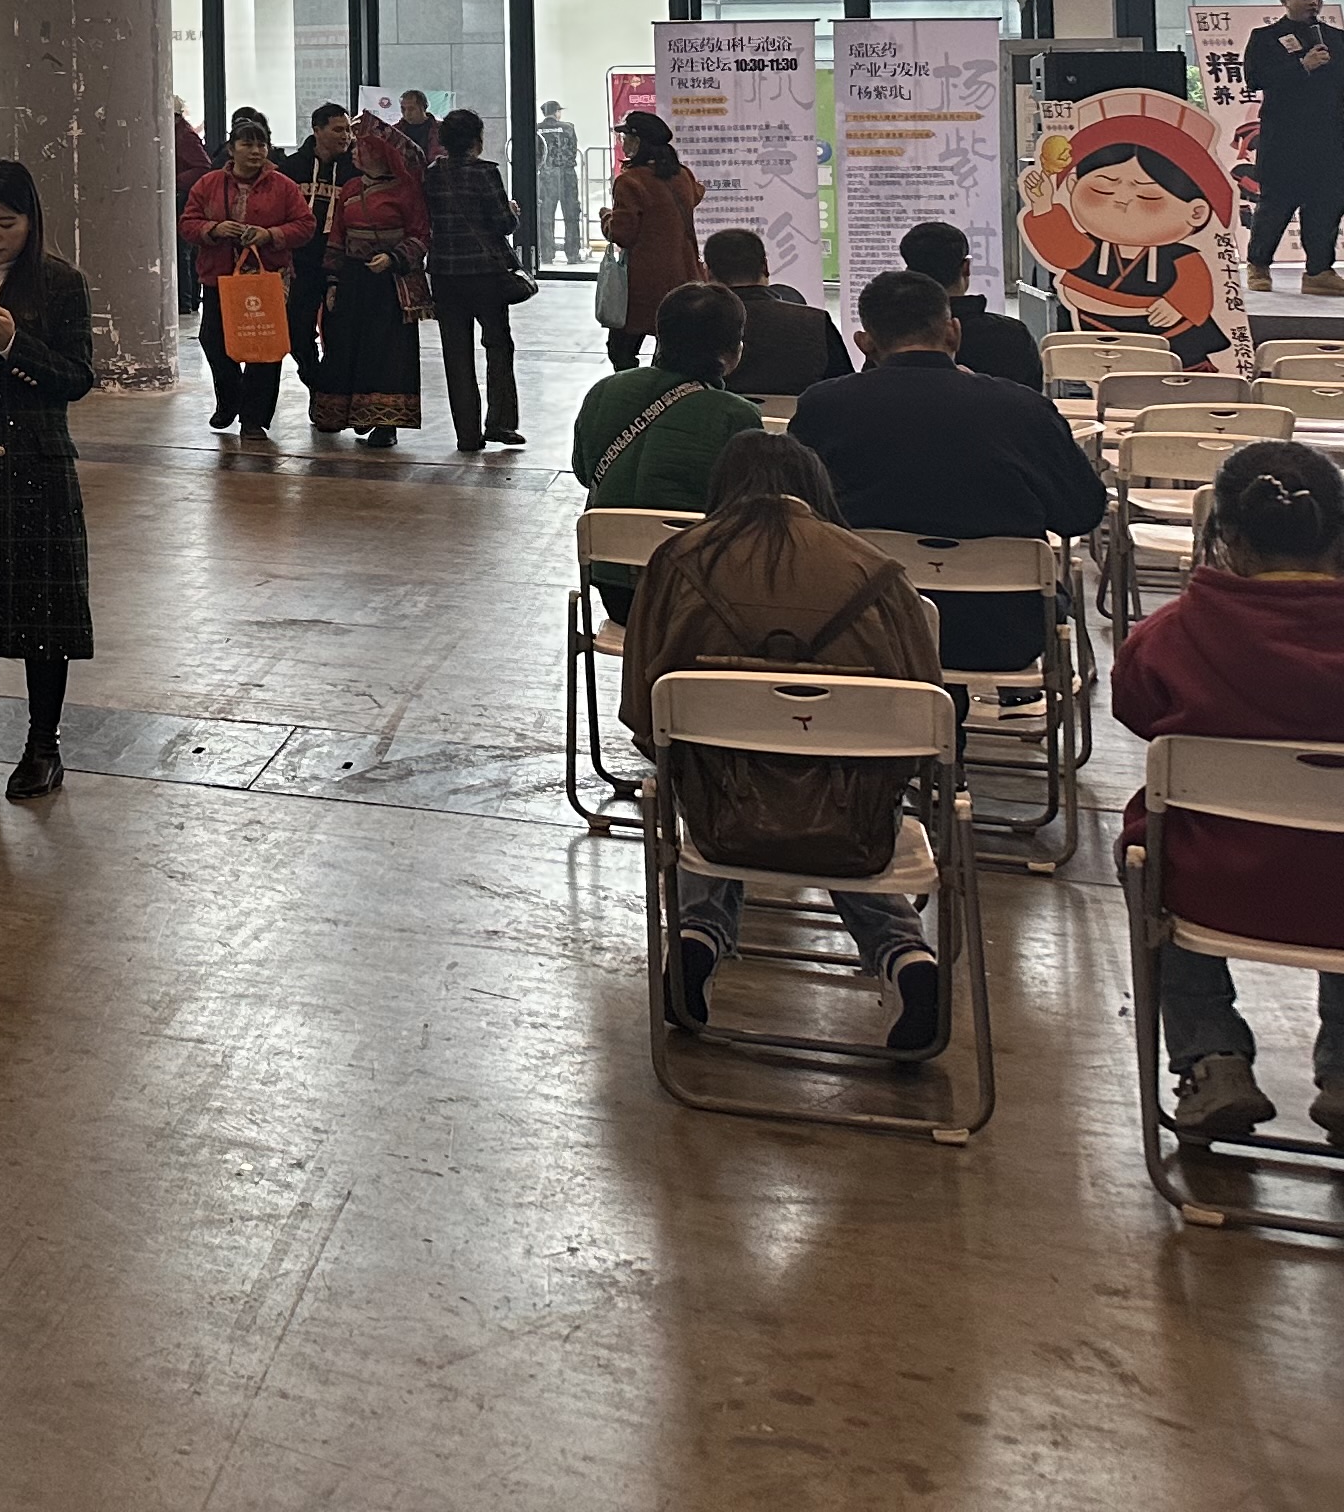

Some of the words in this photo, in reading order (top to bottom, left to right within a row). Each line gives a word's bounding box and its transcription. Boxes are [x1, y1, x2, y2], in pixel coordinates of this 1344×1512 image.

[668, 36, 793, 54] 瑶医药妇科与泡浴
[848, 41, 897, 58] 瑶医药
[670, 57, 732, 73] 养生论坛
[733, 57, 798, 72] 10:30-11:30
[849, 61, 931, 78] 产业与发展
[1205, 51, 1245, 84] 精
[1213, 86, 1262, 106] 养生
